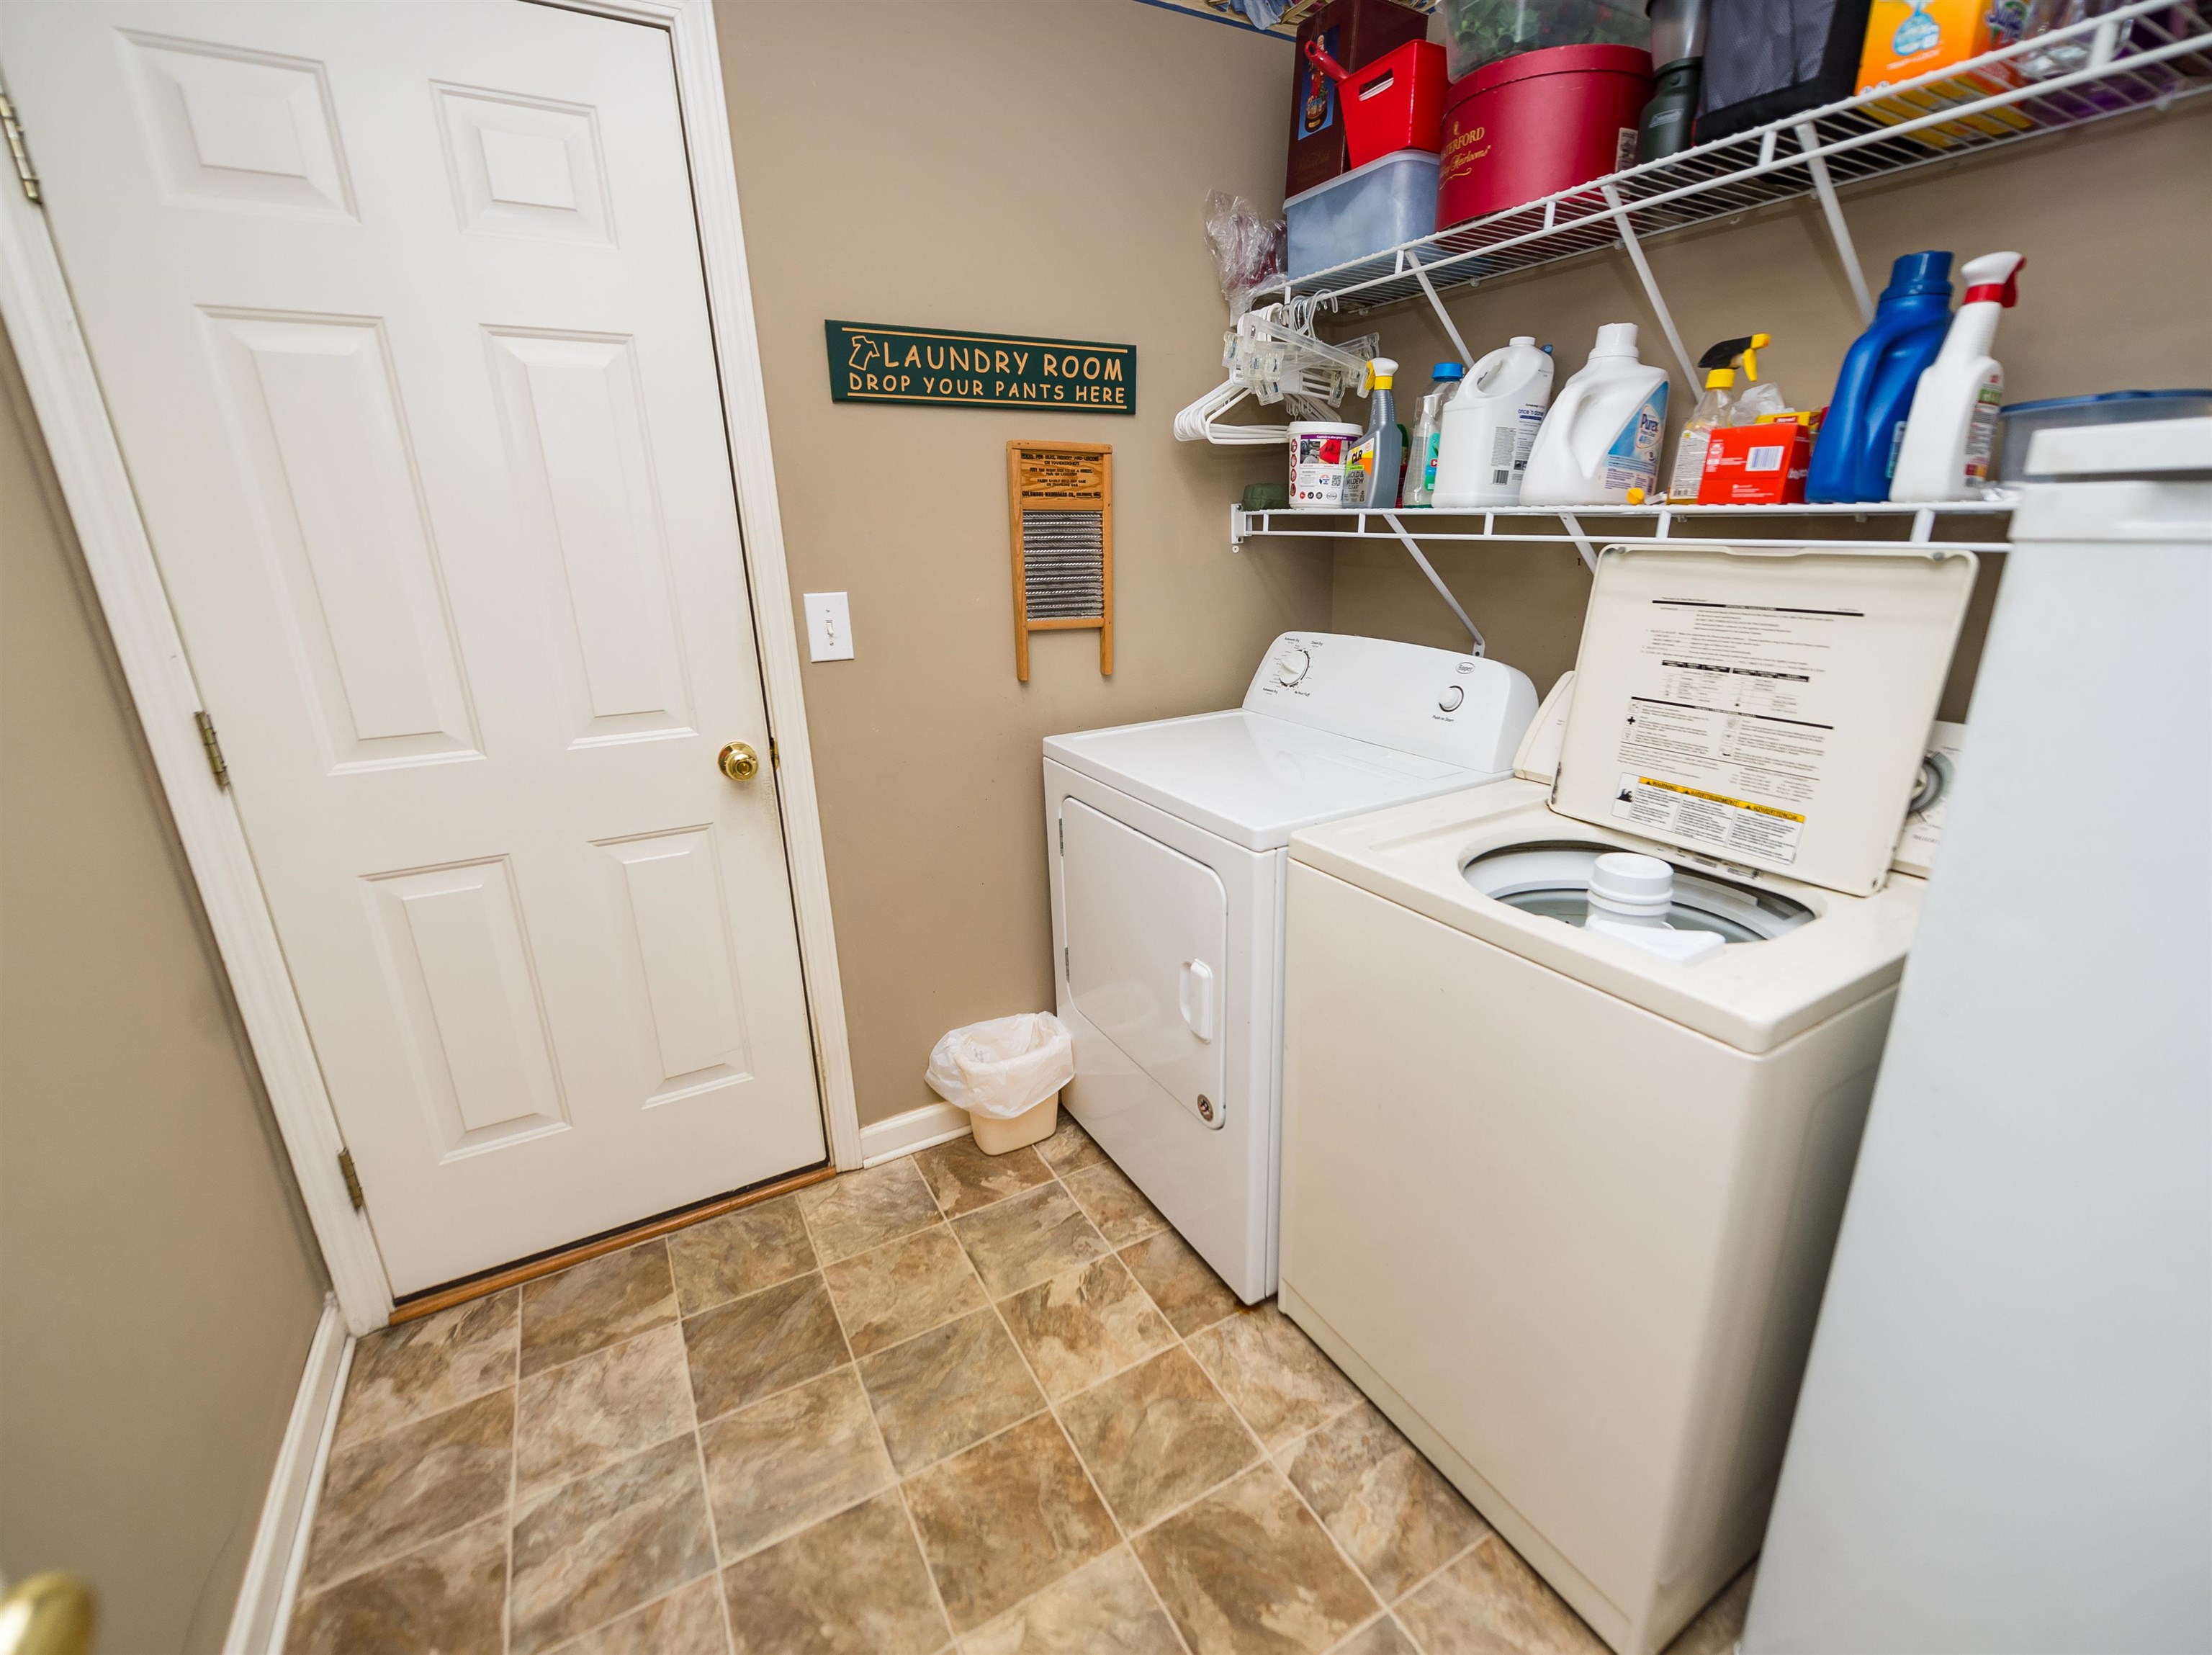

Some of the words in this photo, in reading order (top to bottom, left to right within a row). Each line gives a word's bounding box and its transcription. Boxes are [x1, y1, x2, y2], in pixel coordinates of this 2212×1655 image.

[1441, 127, 1485, 158] ATERFORD
[884, 341, 1029, 375] LAUNDRY
[1043, 354, 1123, 382] ROOM
[849, 372, 911, 392] DROP
[924, 377, 984, 396] YOUR
[996, 382, 1064, 401] PANTS
[1076, 385, 1125, 404] HERE
[1641, 414, 1659, 432] Purex
[1352, 449, 1363, 464] CLR
